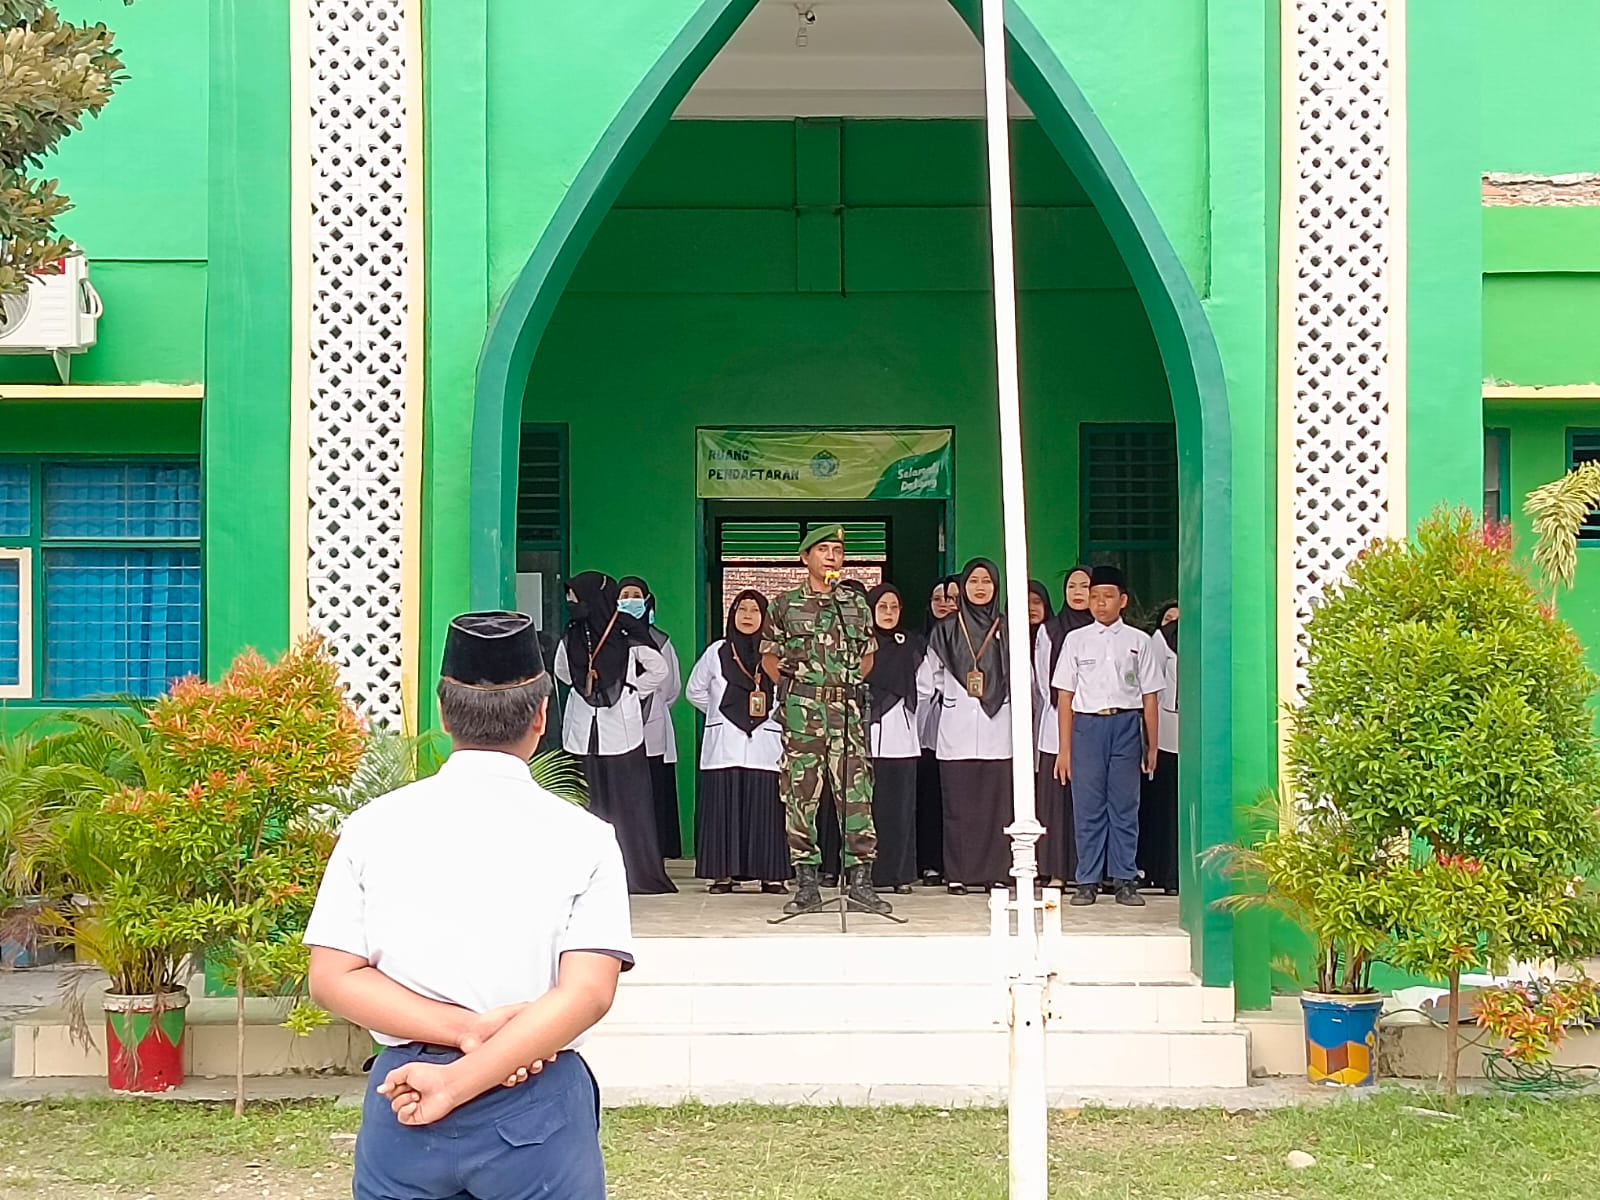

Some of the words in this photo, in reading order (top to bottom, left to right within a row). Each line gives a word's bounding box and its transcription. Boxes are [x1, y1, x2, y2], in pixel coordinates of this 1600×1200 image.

[708, 449, 750, 461] RUANG
[708, 468, 799, 481] PENDAFTARAN
[897, 461, 940, 480] Selam
